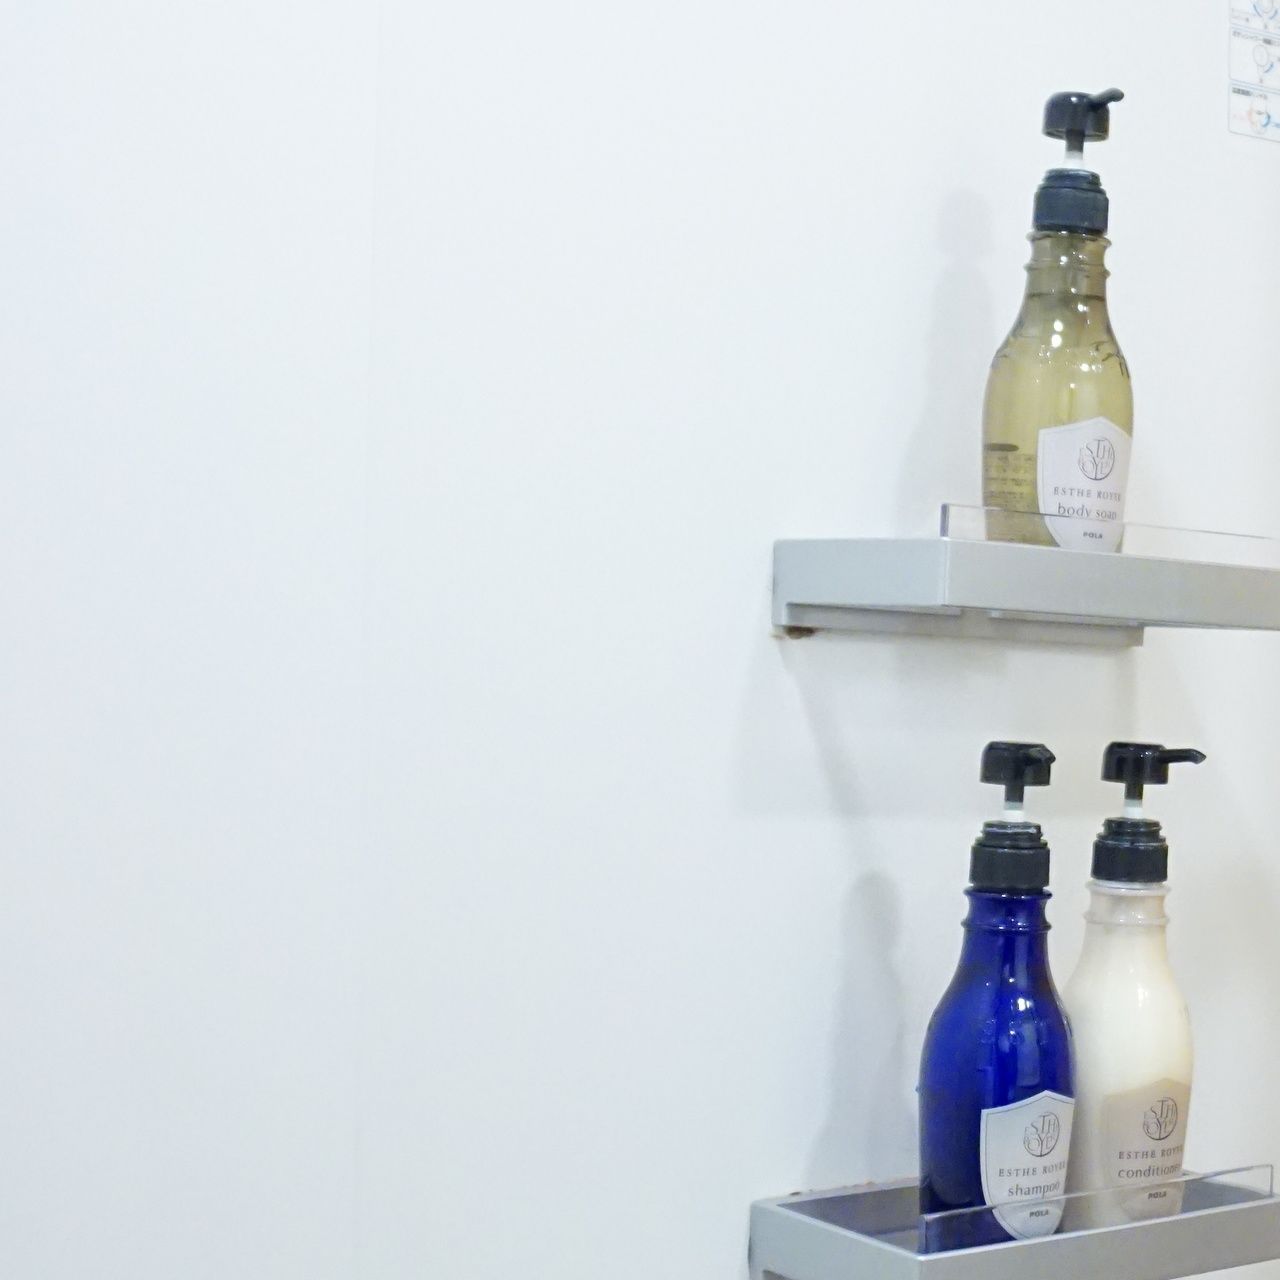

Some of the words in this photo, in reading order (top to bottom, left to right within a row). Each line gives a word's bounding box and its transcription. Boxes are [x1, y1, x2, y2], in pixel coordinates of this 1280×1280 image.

[1053, 486, 1092, 498] ESTHE
[1057, 502, 1092, 518] body
[1095, 509, 1117, 521] soap
[1083, 531, 1103, 539] POLA
[1118, 1150, 1156, 1160] ESTHE
[998, 1167, 1037, 1177] ESTHE
[1008, 1180, 1060, 1199] shampoo
[1147, 1191, 1167, 1200] POLA
[1029, 1209, 1049, 1218] POLA
